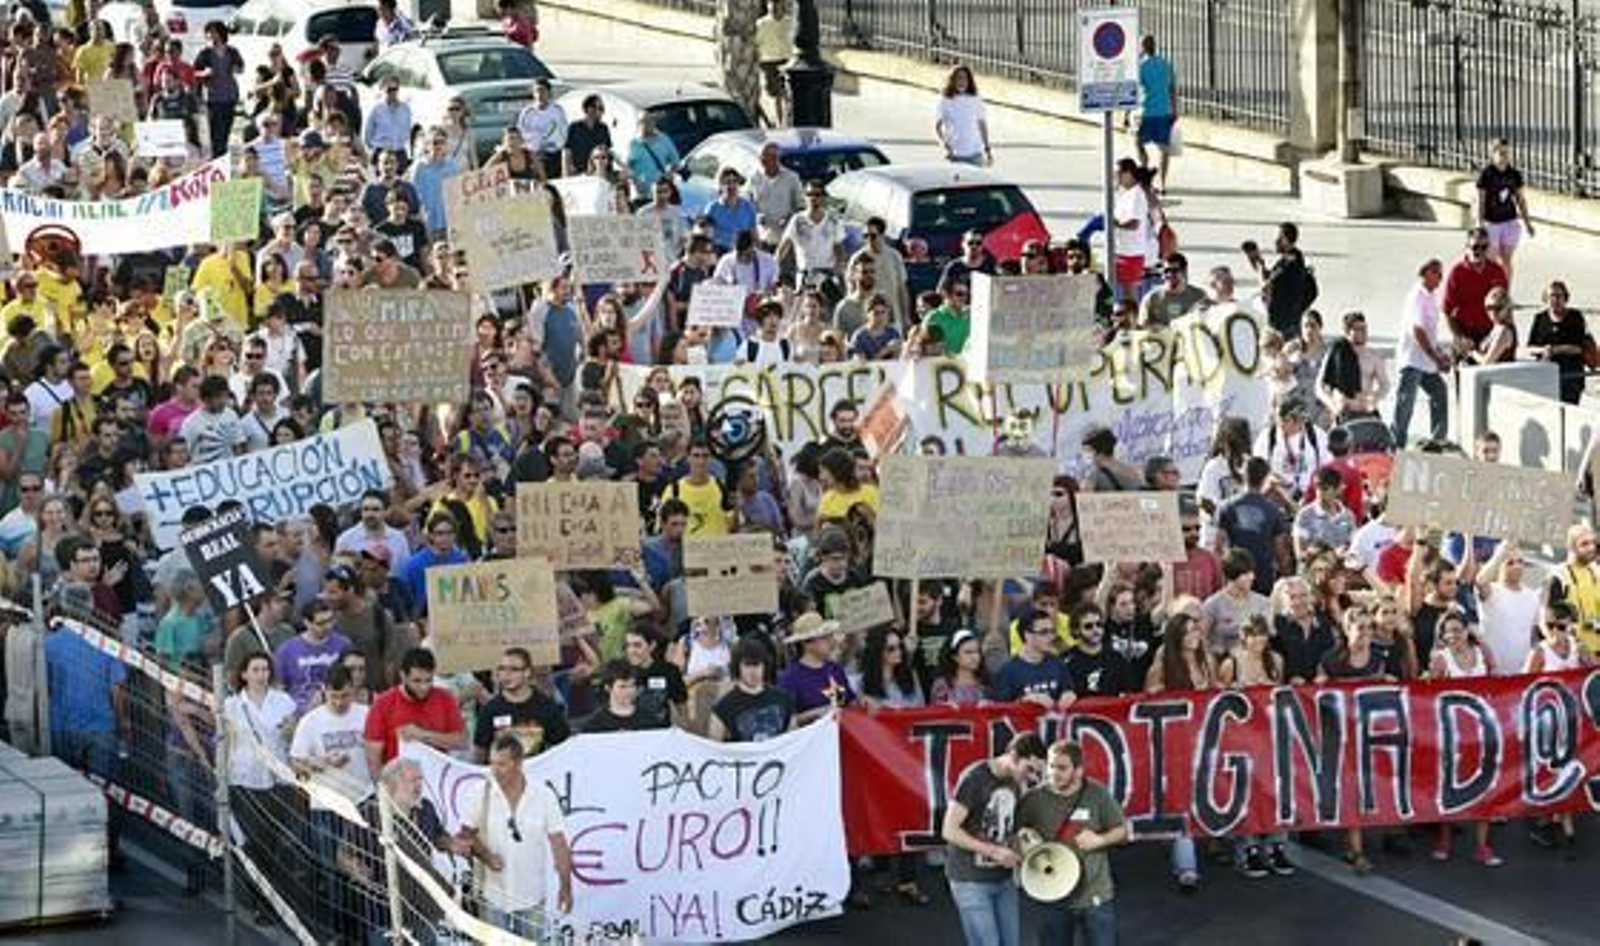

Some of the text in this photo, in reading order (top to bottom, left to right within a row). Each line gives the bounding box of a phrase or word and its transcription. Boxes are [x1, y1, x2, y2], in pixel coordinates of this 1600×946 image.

[722, 362, 886, 441] CÁRCE
[200, 532, 241, 562] REAL
[210, 562, 266, 609] YA
[641, 759, 785, 806] PACTO
